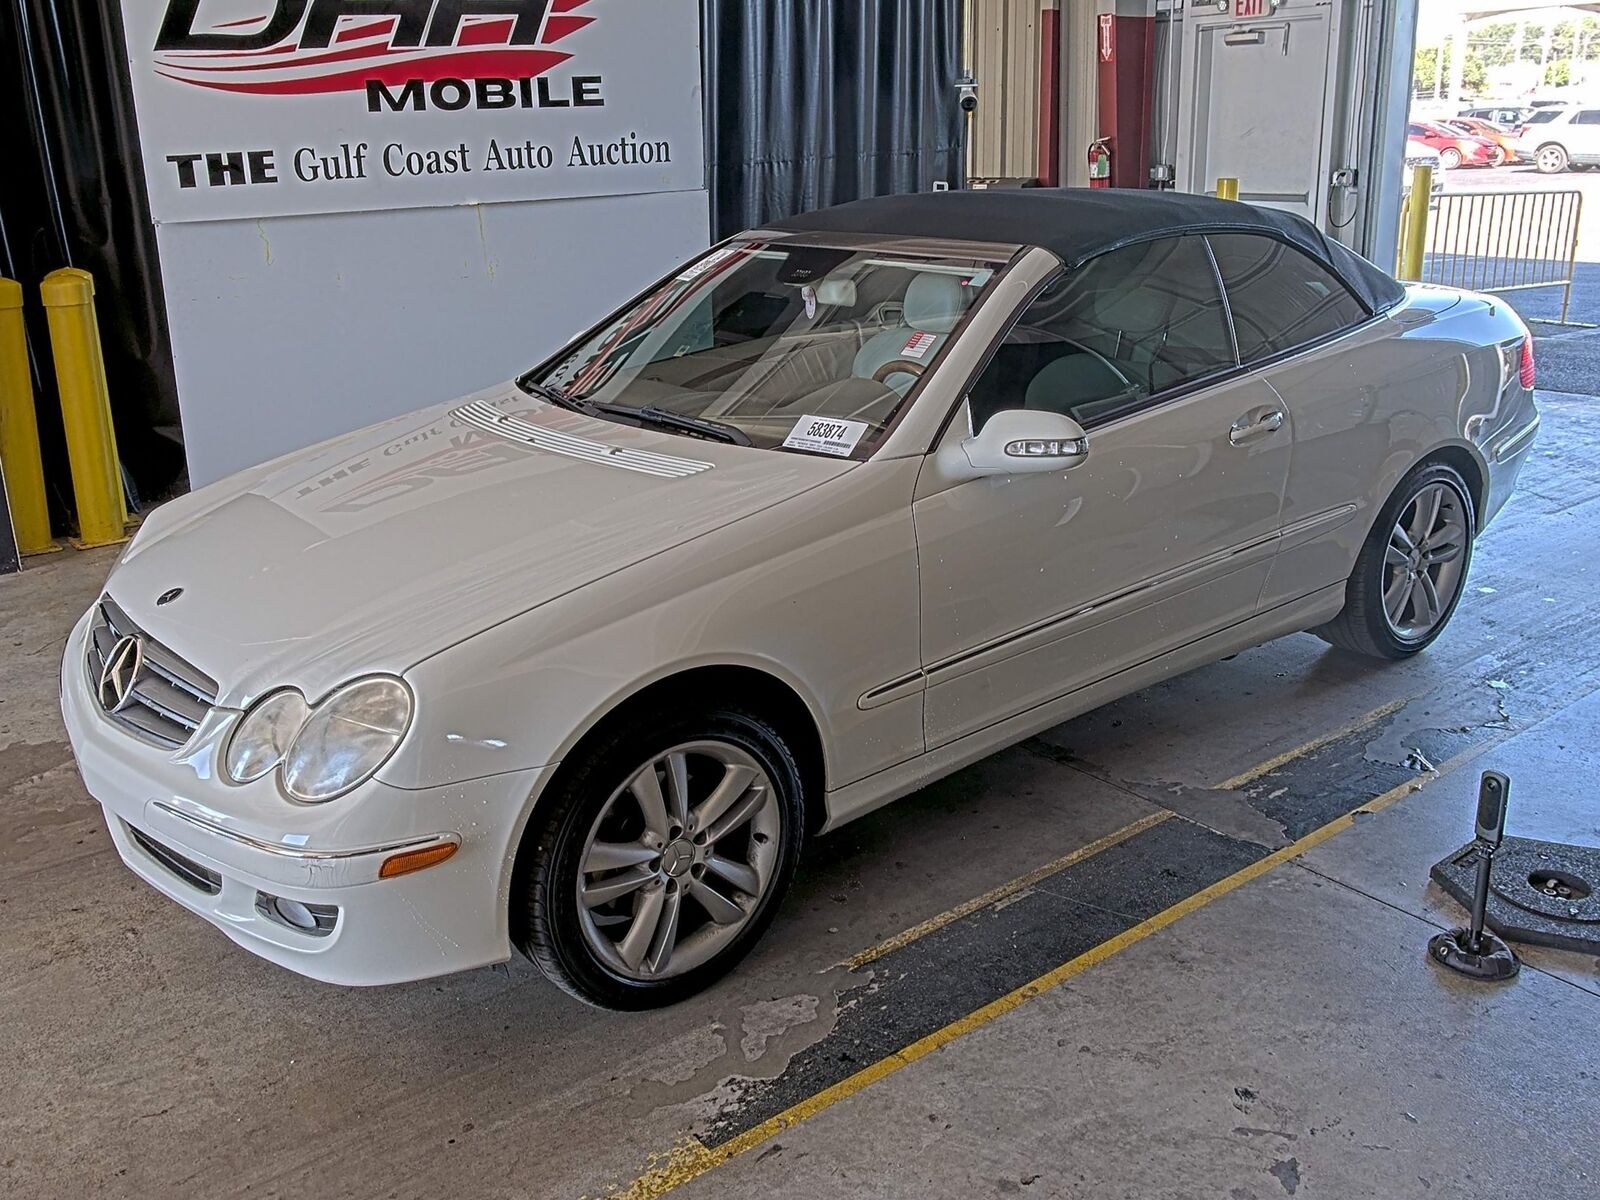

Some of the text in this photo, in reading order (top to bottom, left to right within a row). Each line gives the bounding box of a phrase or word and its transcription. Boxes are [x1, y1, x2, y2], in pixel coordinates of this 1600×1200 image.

[365, 75, 605, 113] MOBILE
[166, 131, 672, 189] THE Gulf Coast Auto Auction
[806, 421, 848, 441] 583874
